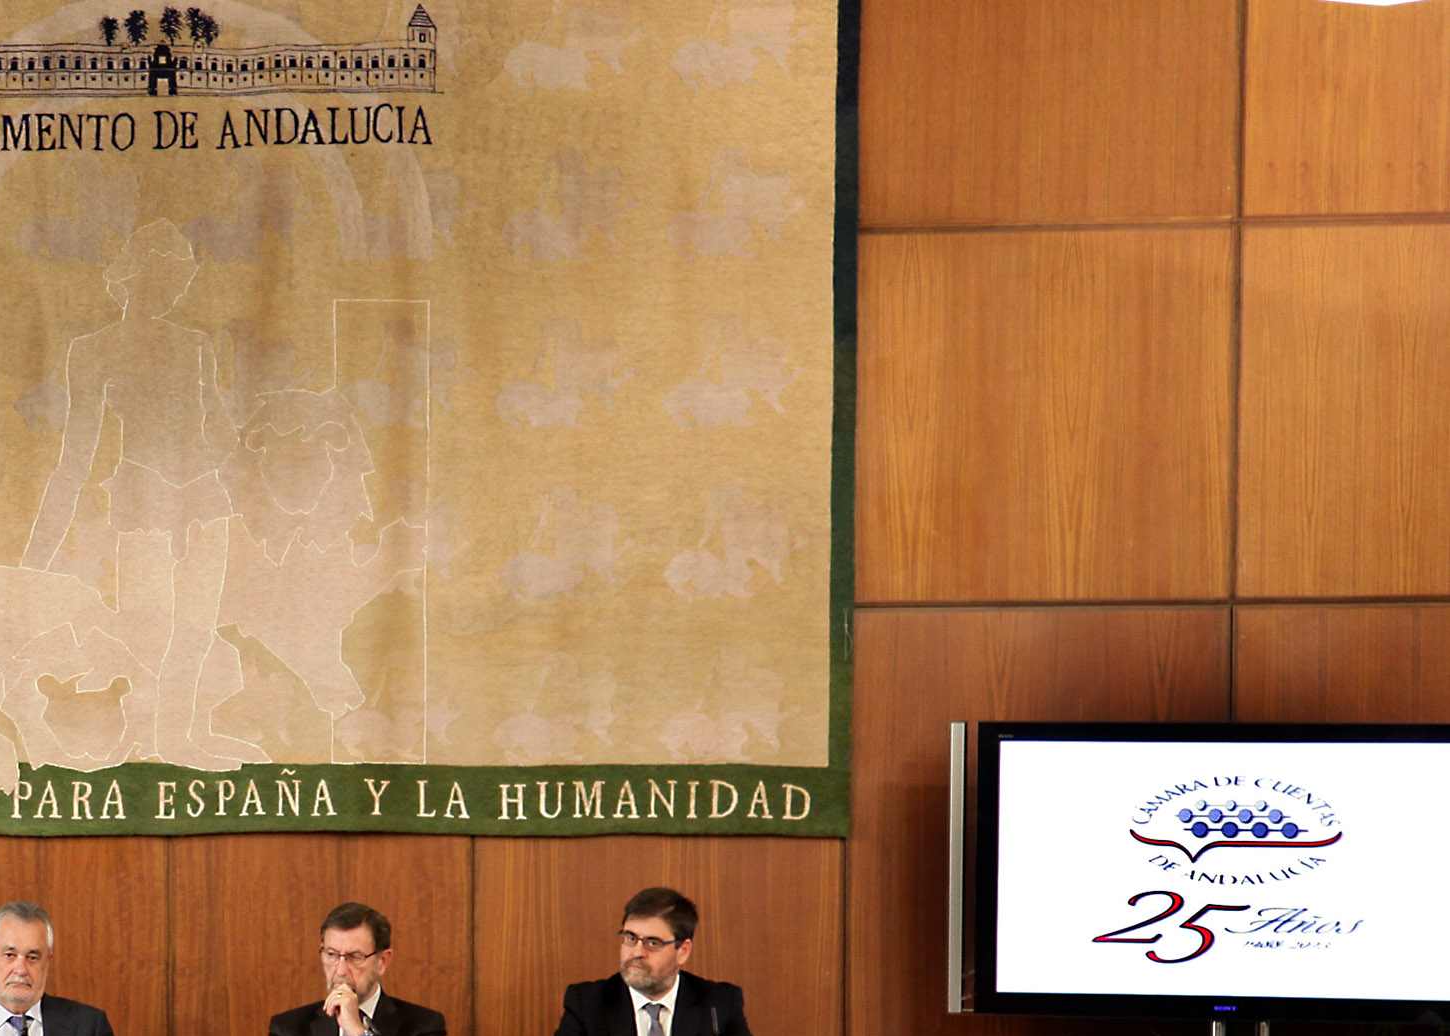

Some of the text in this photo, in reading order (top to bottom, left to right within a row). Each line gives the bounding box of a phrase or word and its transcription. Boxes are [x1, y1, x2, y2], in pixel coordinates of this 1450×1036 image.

[152, 110, 199, 150] DE
[216, 102, 433, 150] ANDALUCIA
[12, 780, 127, 821] PARA
[154, 768, 338, 820] ESPAÑA
[363, 777, 391, 816] Y
[417, 779, 471, 820] LA
[497, 778, 811, 821] HUMANIDAD
[1213, 775, 1246, 787] DE
[1254, 777, 1341, 827] CUENTAS
[1148, 854, 1181, 871] DE
[1091, 890, 1364, 964] 25 Años
